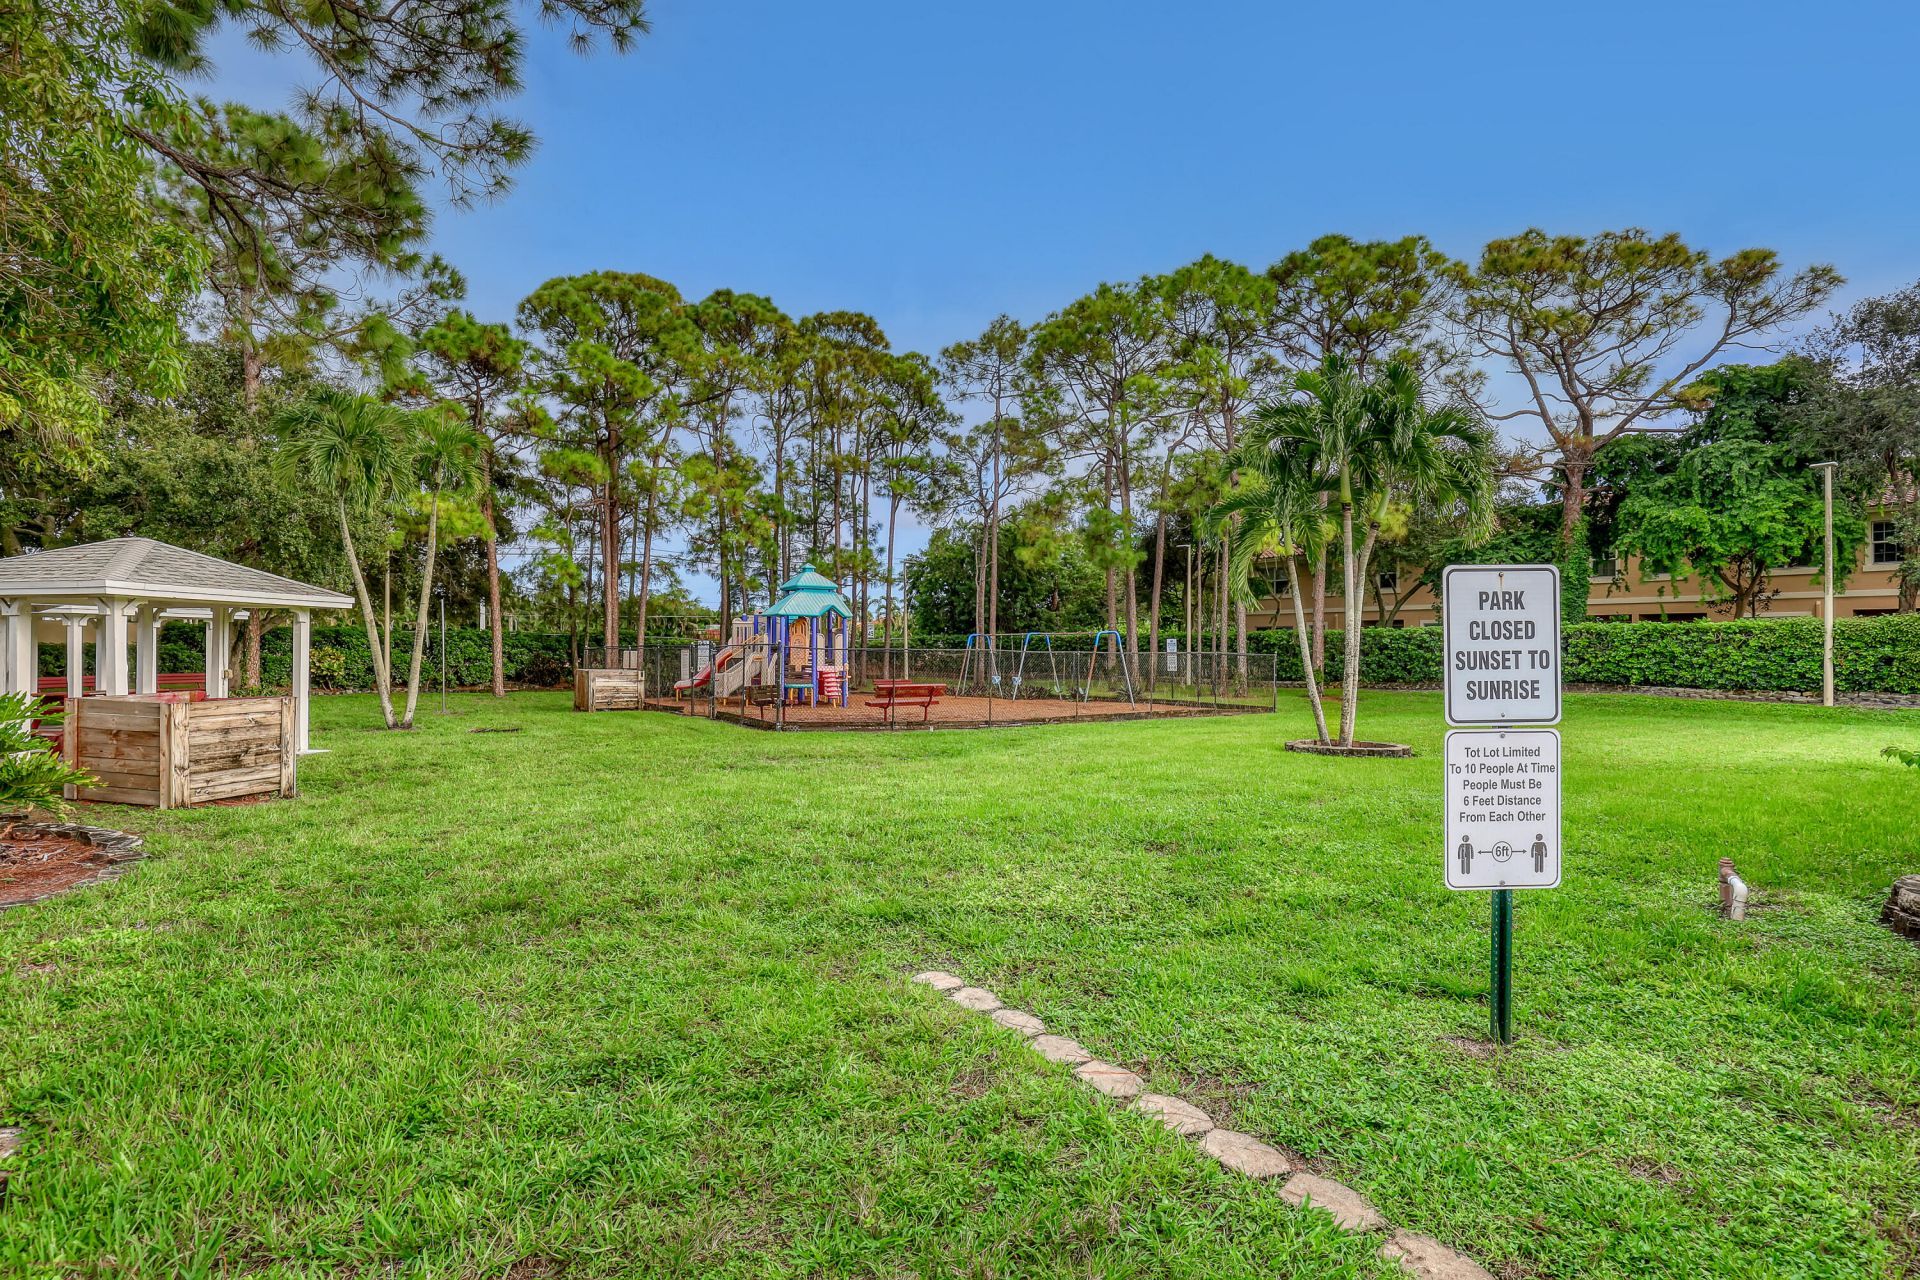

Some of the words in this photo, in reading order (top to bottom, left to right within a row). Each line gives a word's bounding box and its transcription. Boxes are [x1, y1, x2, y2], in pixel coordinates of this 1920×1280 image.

[1478, 590, 1526, 611] PARK
[1469, 620, 1536, 641] CLOSED
[1455, 650, 1523, 671] SUNSET
[1527, 649, 1550, 670] TO
[1466, 680, 1541, 701] SUNRISE
[1464, 747, 1481, 758] Tot
[1483, 747, 1500, 758] Lot
[1502, 746, 1541, 757] Limited
[1449, 763, 1462, 774] To
[1465, 763, 1477, 774] 10
[1479, 763, 1514, 776] People
[1516, 762, 1528, 773] At
[1531, 762, 1556, 773] Time
[1463, 779, 1498, 792] People
[1500, 779, 1526, 790] Must
[1528, 778, 1542, 789] Be
[1463, 795, 1470, 806] 6
[1472, 795, 1495, 806] Feet
[1497, 795, 1542, 806] Distance
[1459, 811, 1486, 822] From
[1489, 811, 1514, 822] Each
[1517, 810, 1546, 821] Other
[1495, 845, 1509, 857] 6ft
